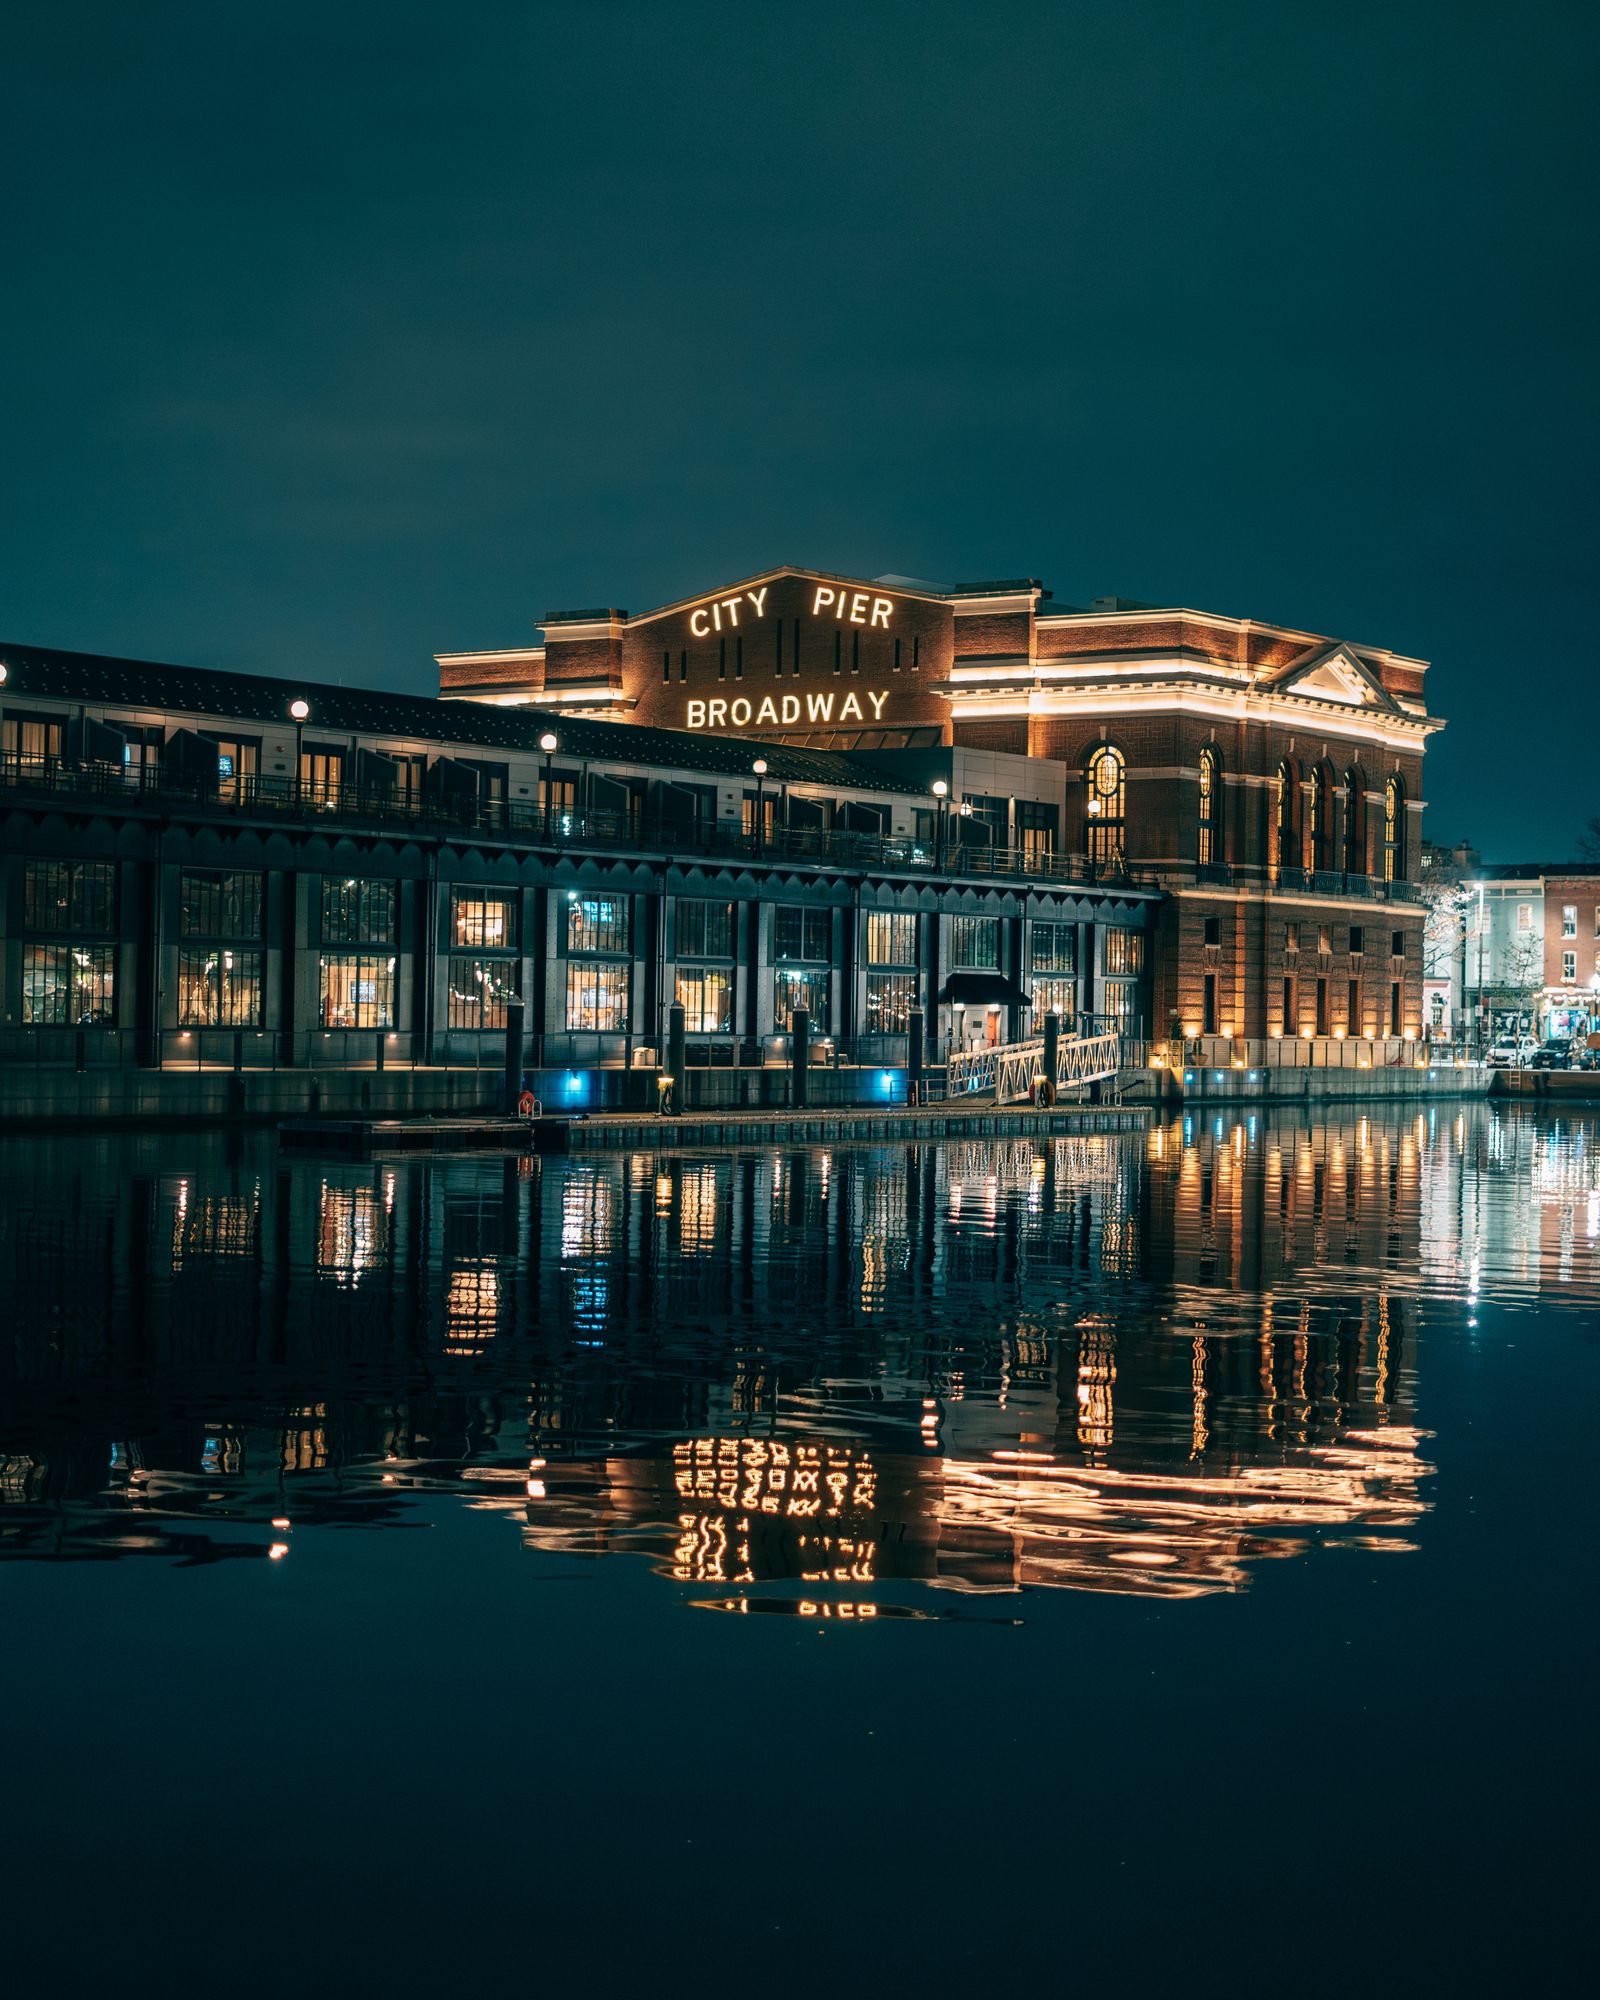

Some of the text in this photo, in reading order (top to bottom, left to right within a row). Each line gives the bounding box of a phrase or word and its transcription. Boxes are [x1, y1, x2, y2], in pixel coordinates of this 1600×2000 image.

[690, 586, 894, 637] CITY PIER
[687, 691, 890, 728] BROADWAY
